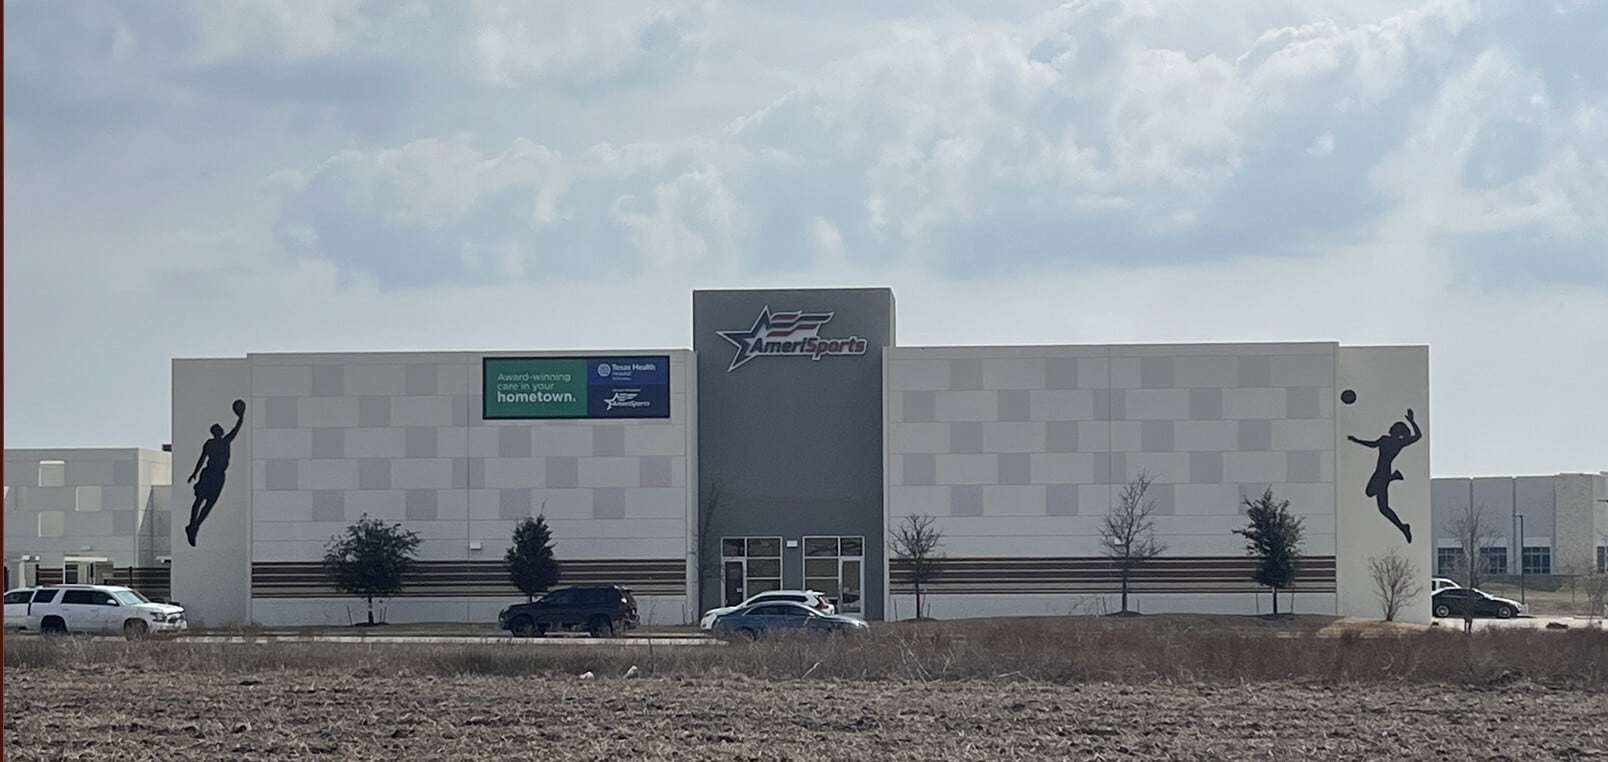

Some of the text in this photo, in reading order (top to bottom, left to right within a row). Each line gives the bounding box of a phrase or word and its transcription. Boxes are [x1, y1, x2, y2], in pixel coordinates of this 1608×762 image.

[750, 337, 866, 357] AmeriSports
[497, 373, 571, 382] Award-winning
[497, 382, 555, 392] care in your
[497, 391, 576, 402] hometown.
